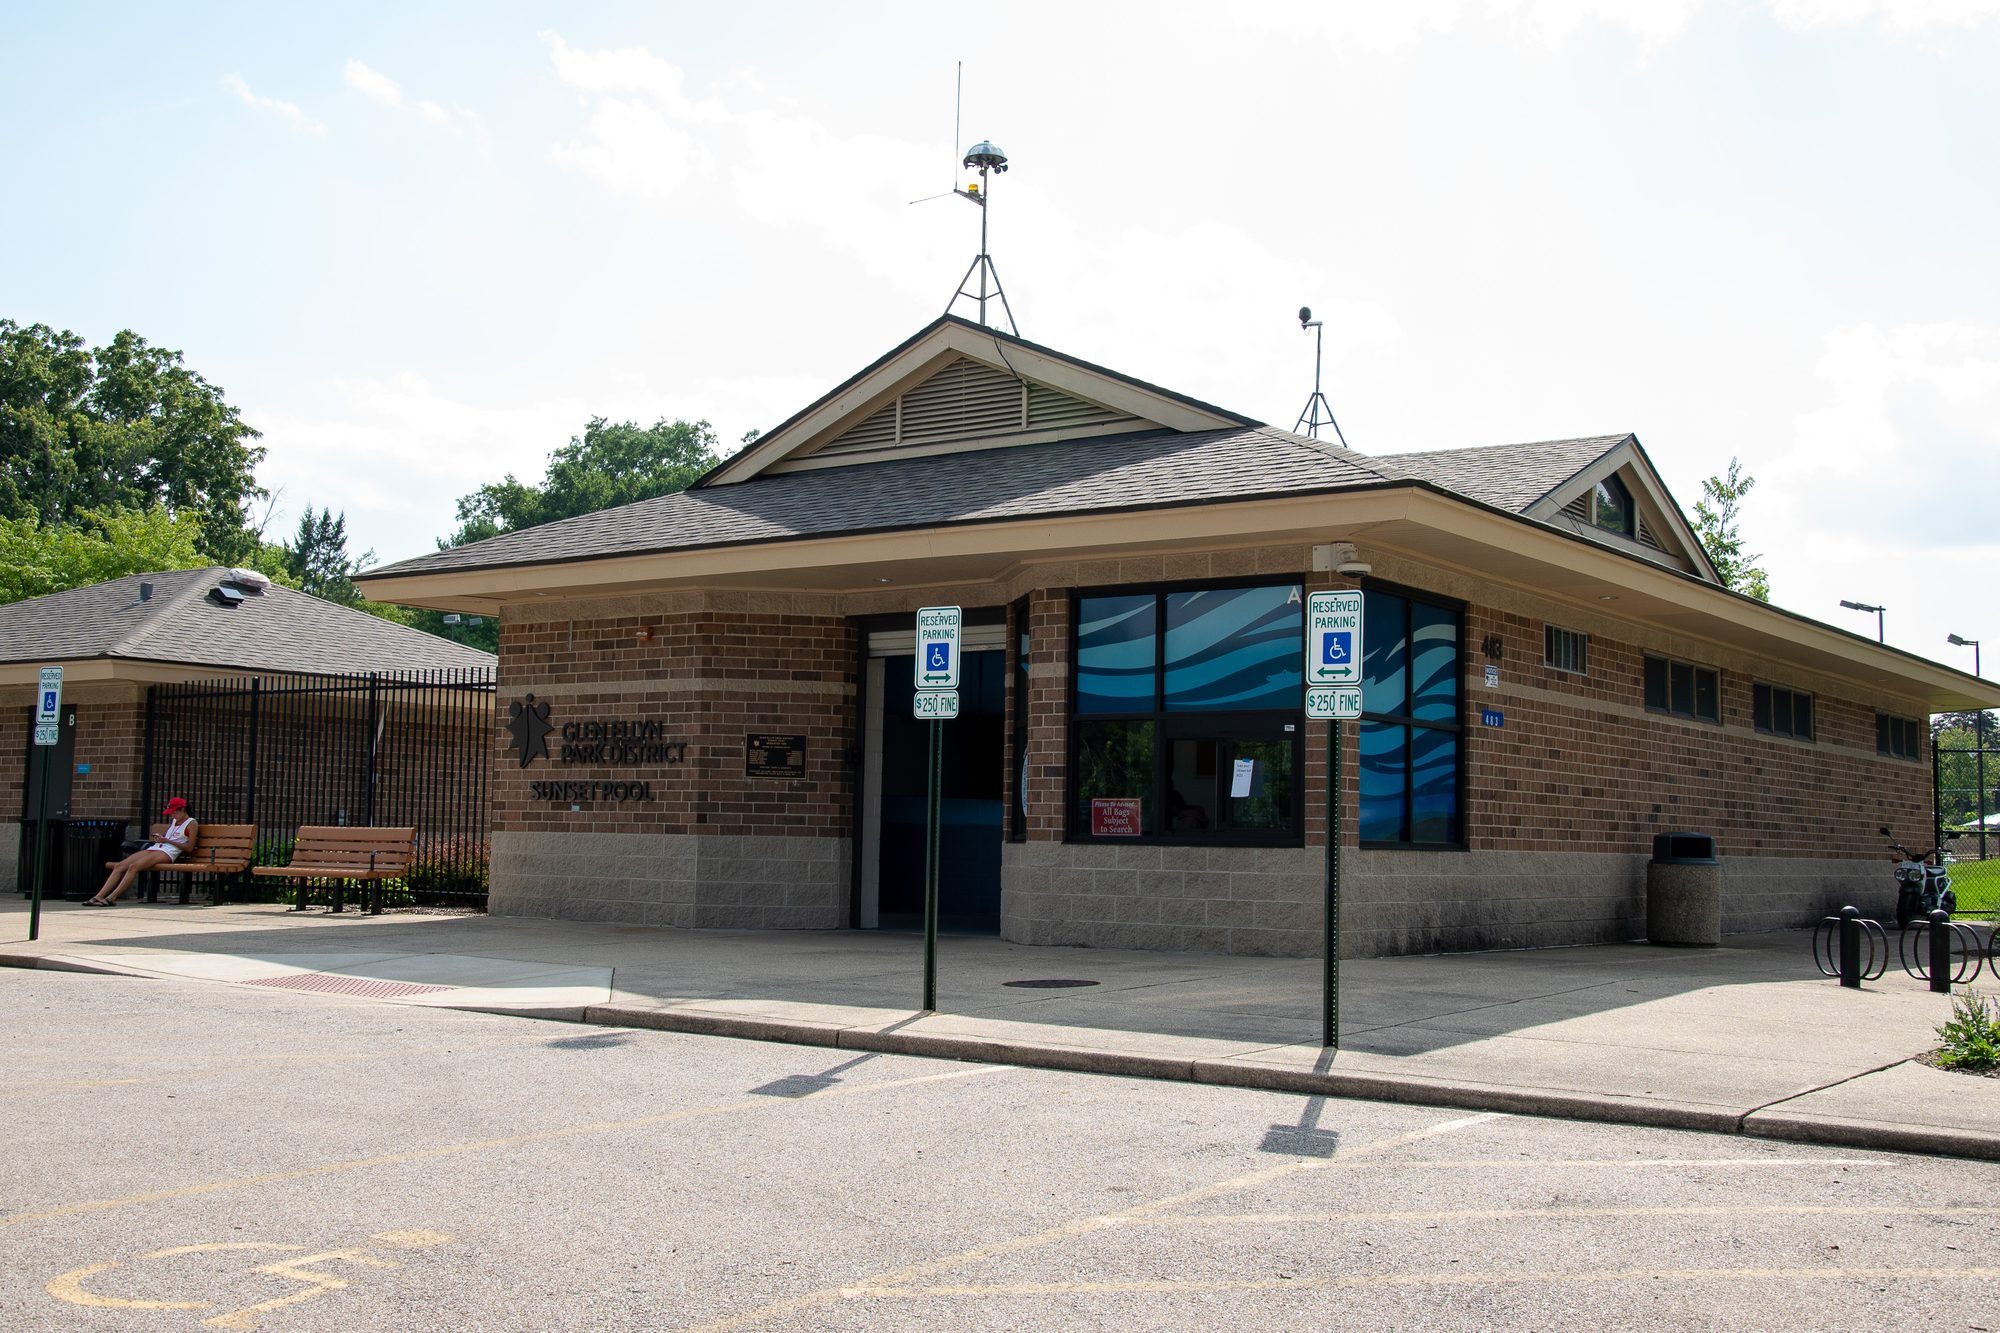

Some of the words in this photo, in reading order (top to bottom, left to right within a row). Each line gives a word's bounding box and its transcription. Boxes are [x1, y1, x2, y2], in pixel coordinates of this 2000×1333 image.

[1287, 586, 1302, 604] A
[1313, 600, 1359, 613] RESERVED
[920, 615, 958, 626] RESERVED
[1315, 616, 1356, 628] PARKING
[922, 629, 955, 640] PARKING
[940, 697, 956, 712] FINE
[1339, 694, 1360, 711] FINE
[69, 714, 75, 726] B
[49, 730, 57, 740] FINE
[562, 721, 608, 742] GLEN
[611, 720, 663, 742] ELLYN
[561, 744, 605, 763] PARK
[610, 743, 687, 763] DISTRICT
[531, 781, 598, 801] SUNSET
[602, 781, 654, 801] POOL
[1114, 808, 1130, 817] Bags
[1104, 816, 1128, 825] Subject
[1109, 825, 1132, 833] Search
